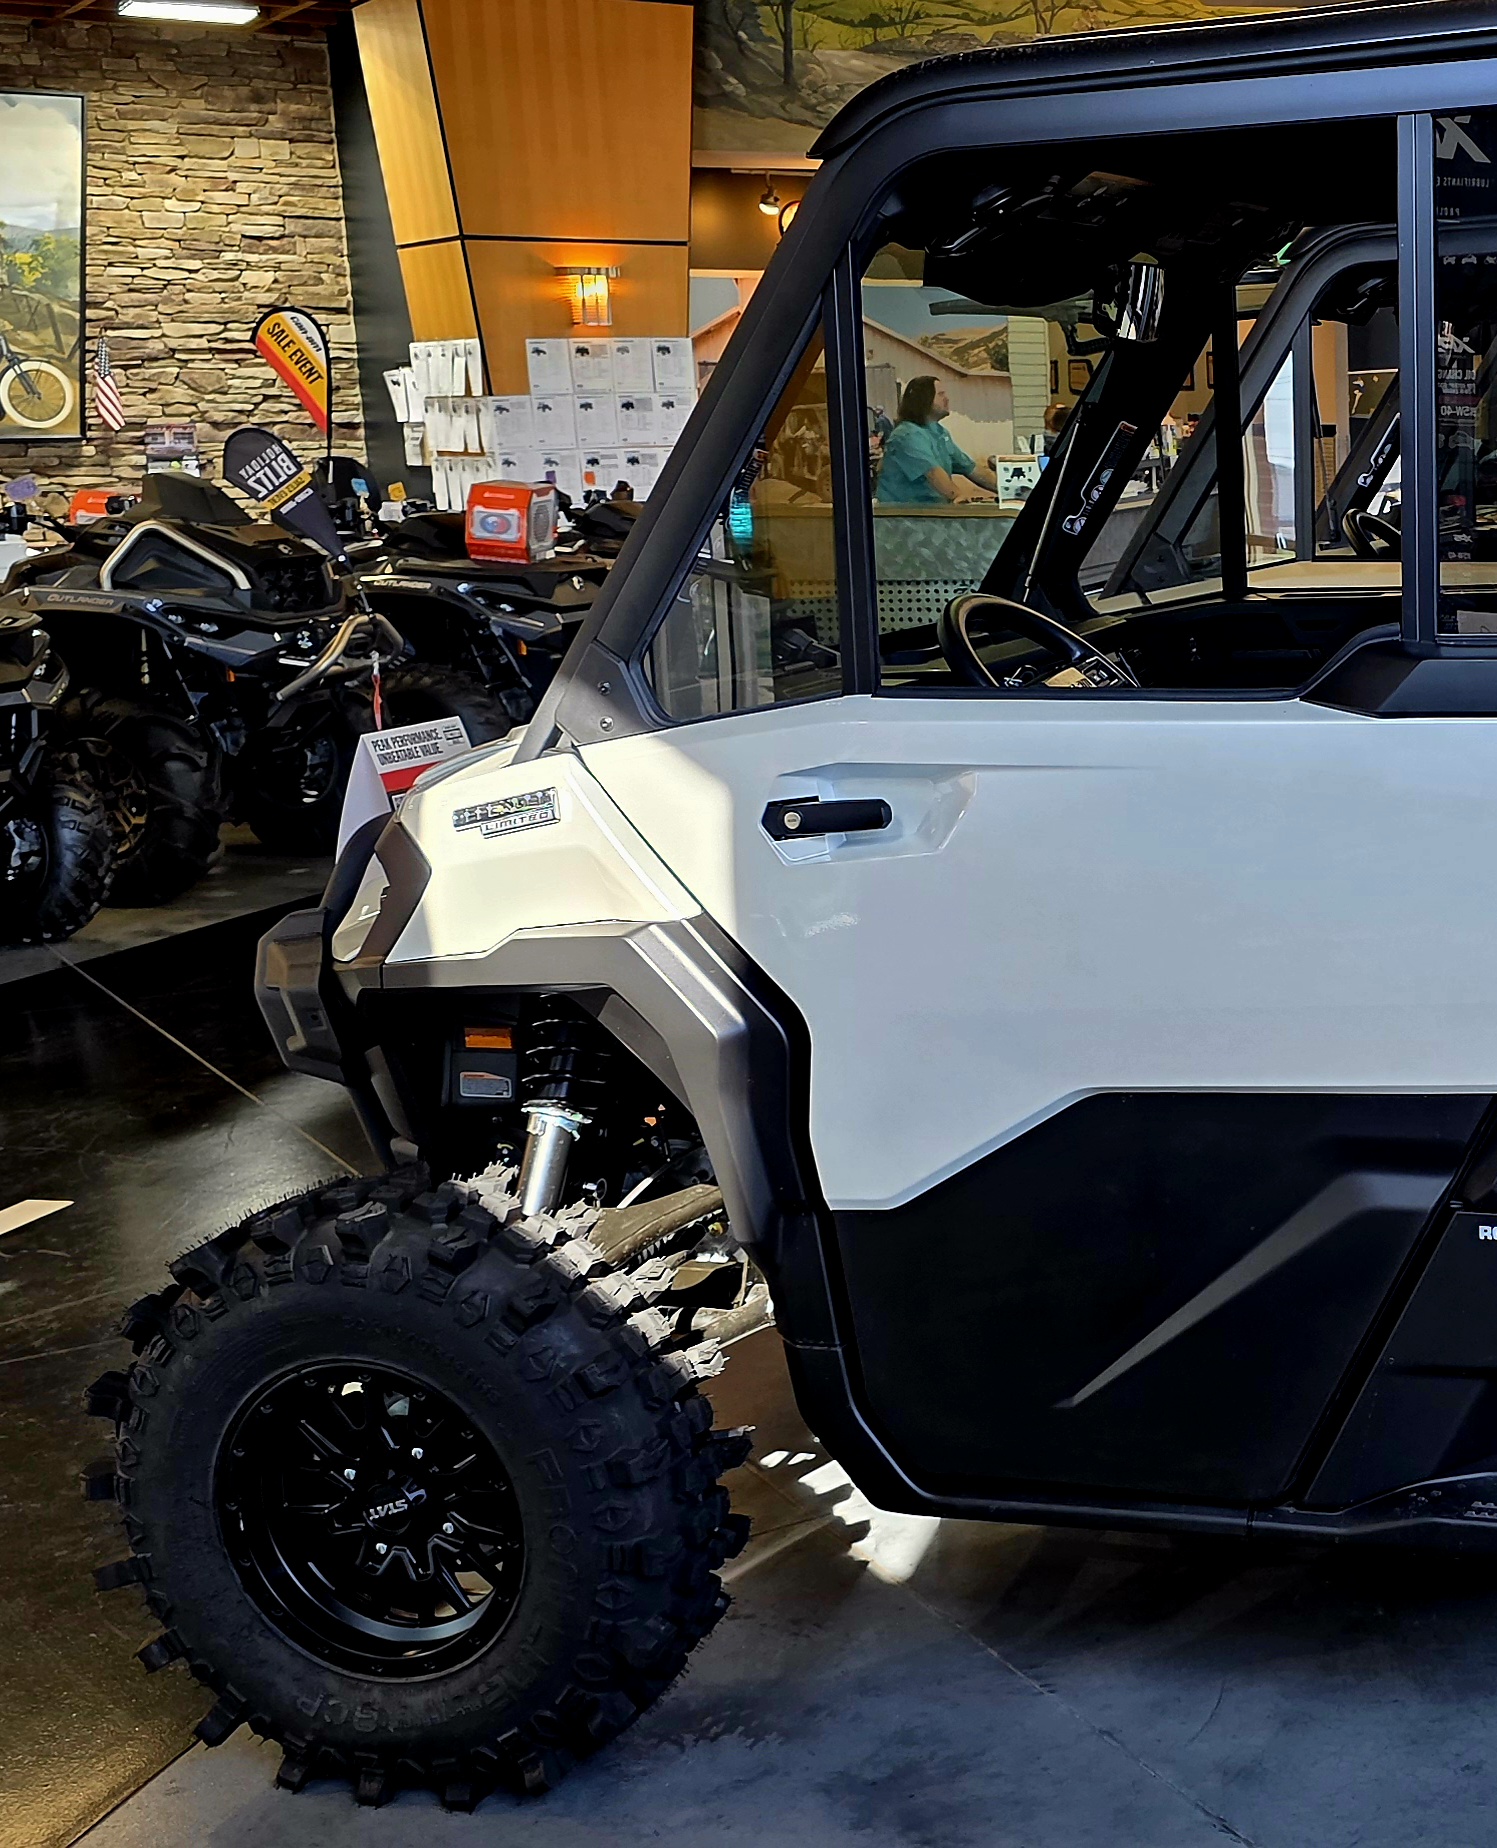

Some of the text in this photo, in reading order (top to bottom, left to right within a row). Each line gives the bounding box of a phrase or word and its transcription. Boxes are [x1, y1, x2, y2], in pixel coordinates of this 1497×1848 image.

[267, 322, 325, 386] SALE EVENT
[46, 592, 115, 606] OUTLANDER
[371, 736, 391, 752] PEAK
[376, 746, 421, 766] UNBEATABLE
[485, 810, 550, 831] LIMITED
[369, 1498, 410, 1522] STAT
